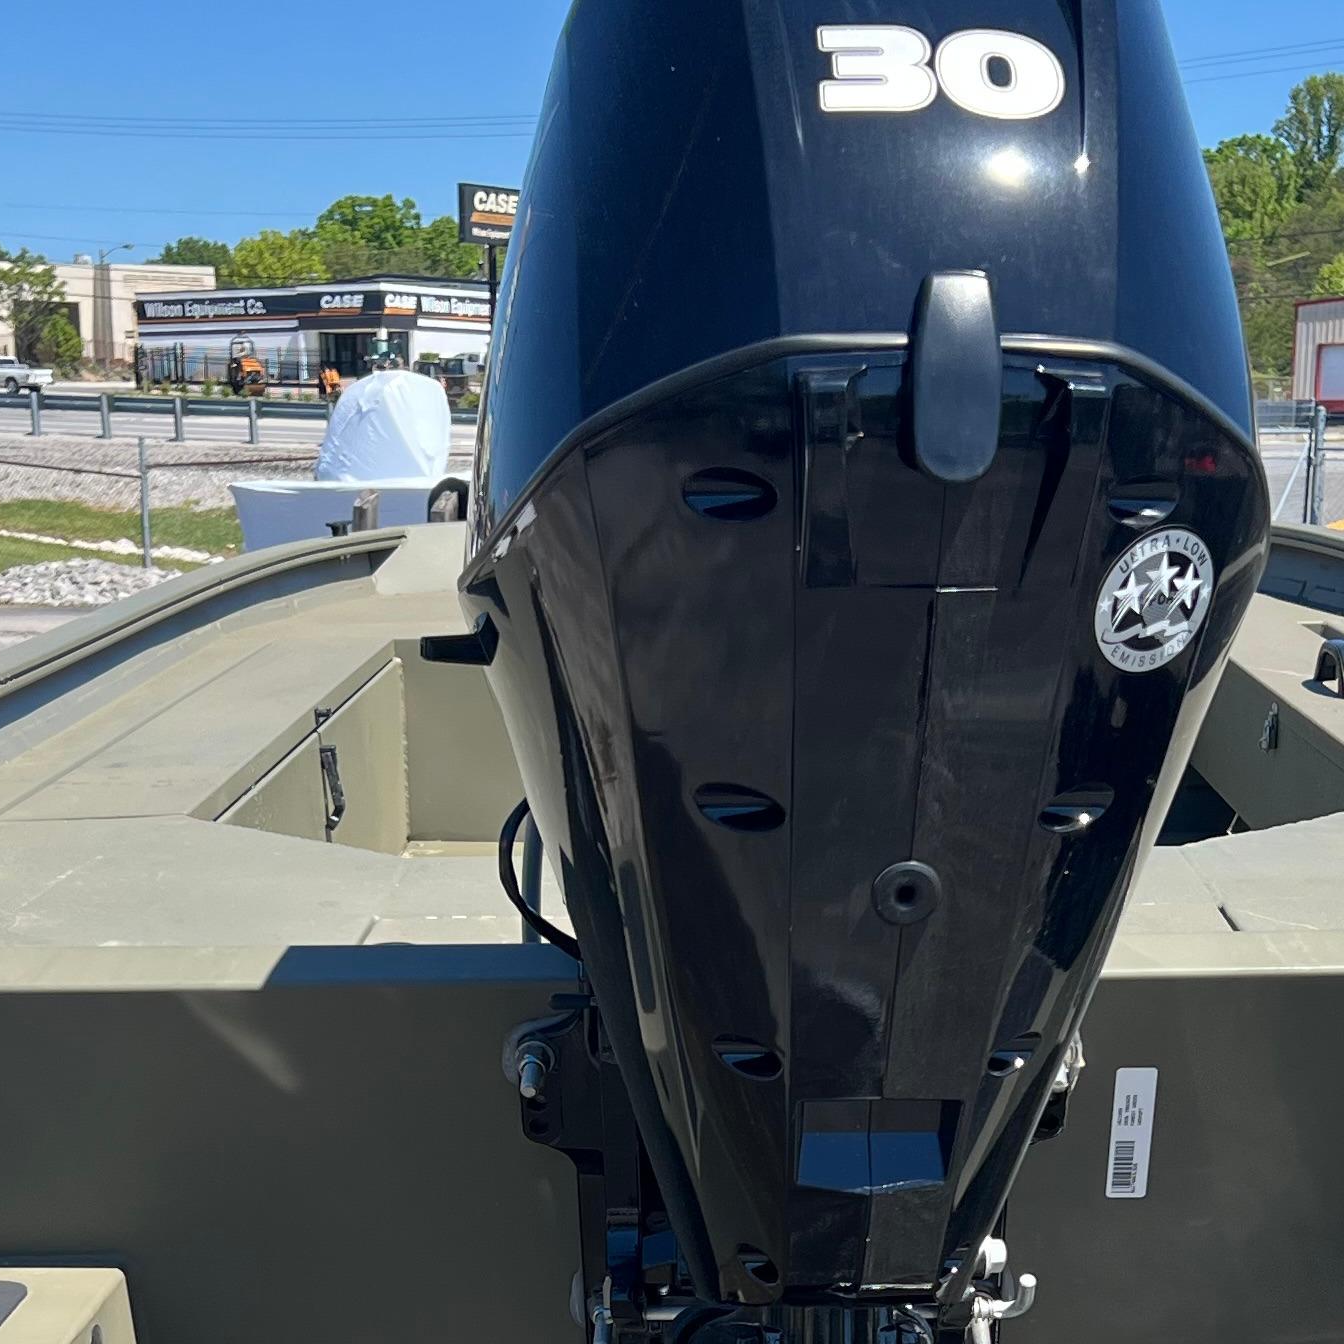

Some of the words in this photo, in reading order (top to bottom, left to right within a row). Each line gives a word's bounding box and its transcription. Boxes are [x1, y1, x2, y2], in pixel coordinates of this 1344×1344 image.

[816, 24, 1065, 120] 30
[474, 191, 519, 214] CASE
[143, 302, 184, 318] Wilson
[184, 299, 246, 319] Equipment
[320, 294, 364, 308] CASE
[384, 294, 417, 309] CASE
[451, 298, 491, 317] Equipmen
[1119, 535, 1171, 574] ULTRA
[1183, 536, 1208, 567] LOW
